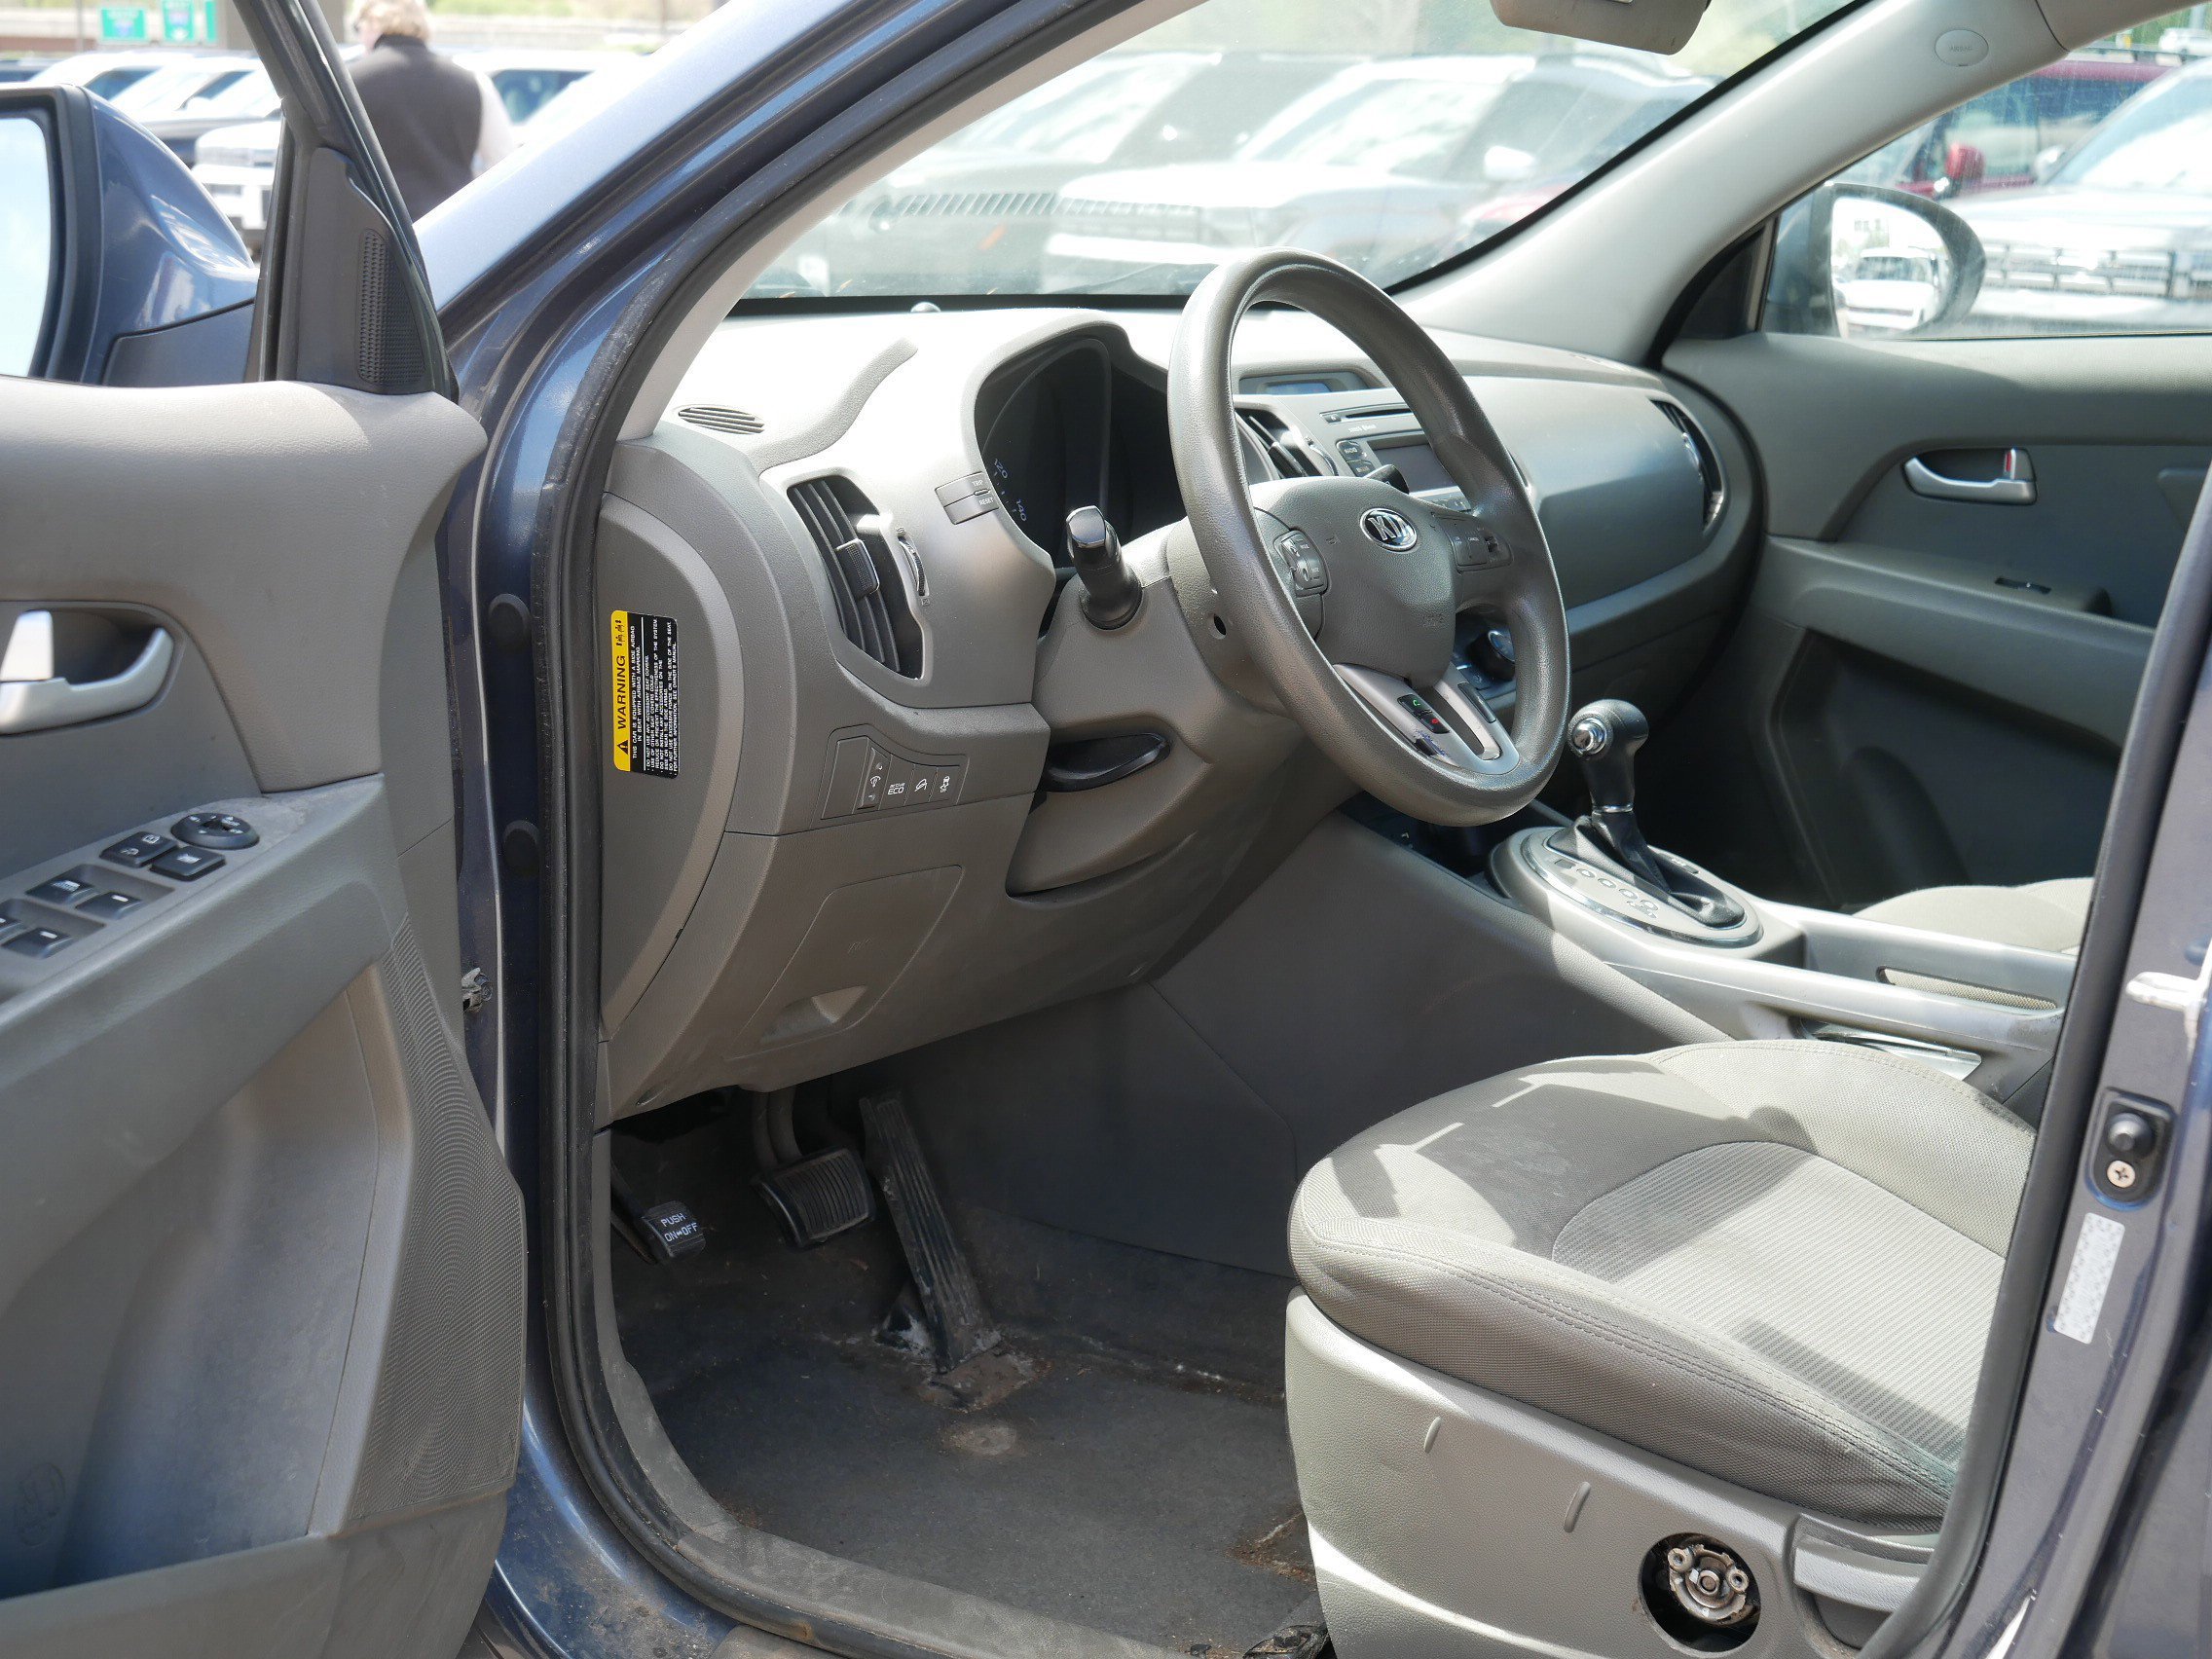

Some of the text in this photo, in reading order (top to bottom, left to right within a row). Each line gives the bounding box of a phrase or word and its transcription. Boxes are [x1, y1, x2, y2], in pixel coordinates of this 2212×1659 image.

[617, 656, 626, 729] WARNING
[887, 786, 904, 795] ECO
[661, 1213, 686, 1227] PUSH
